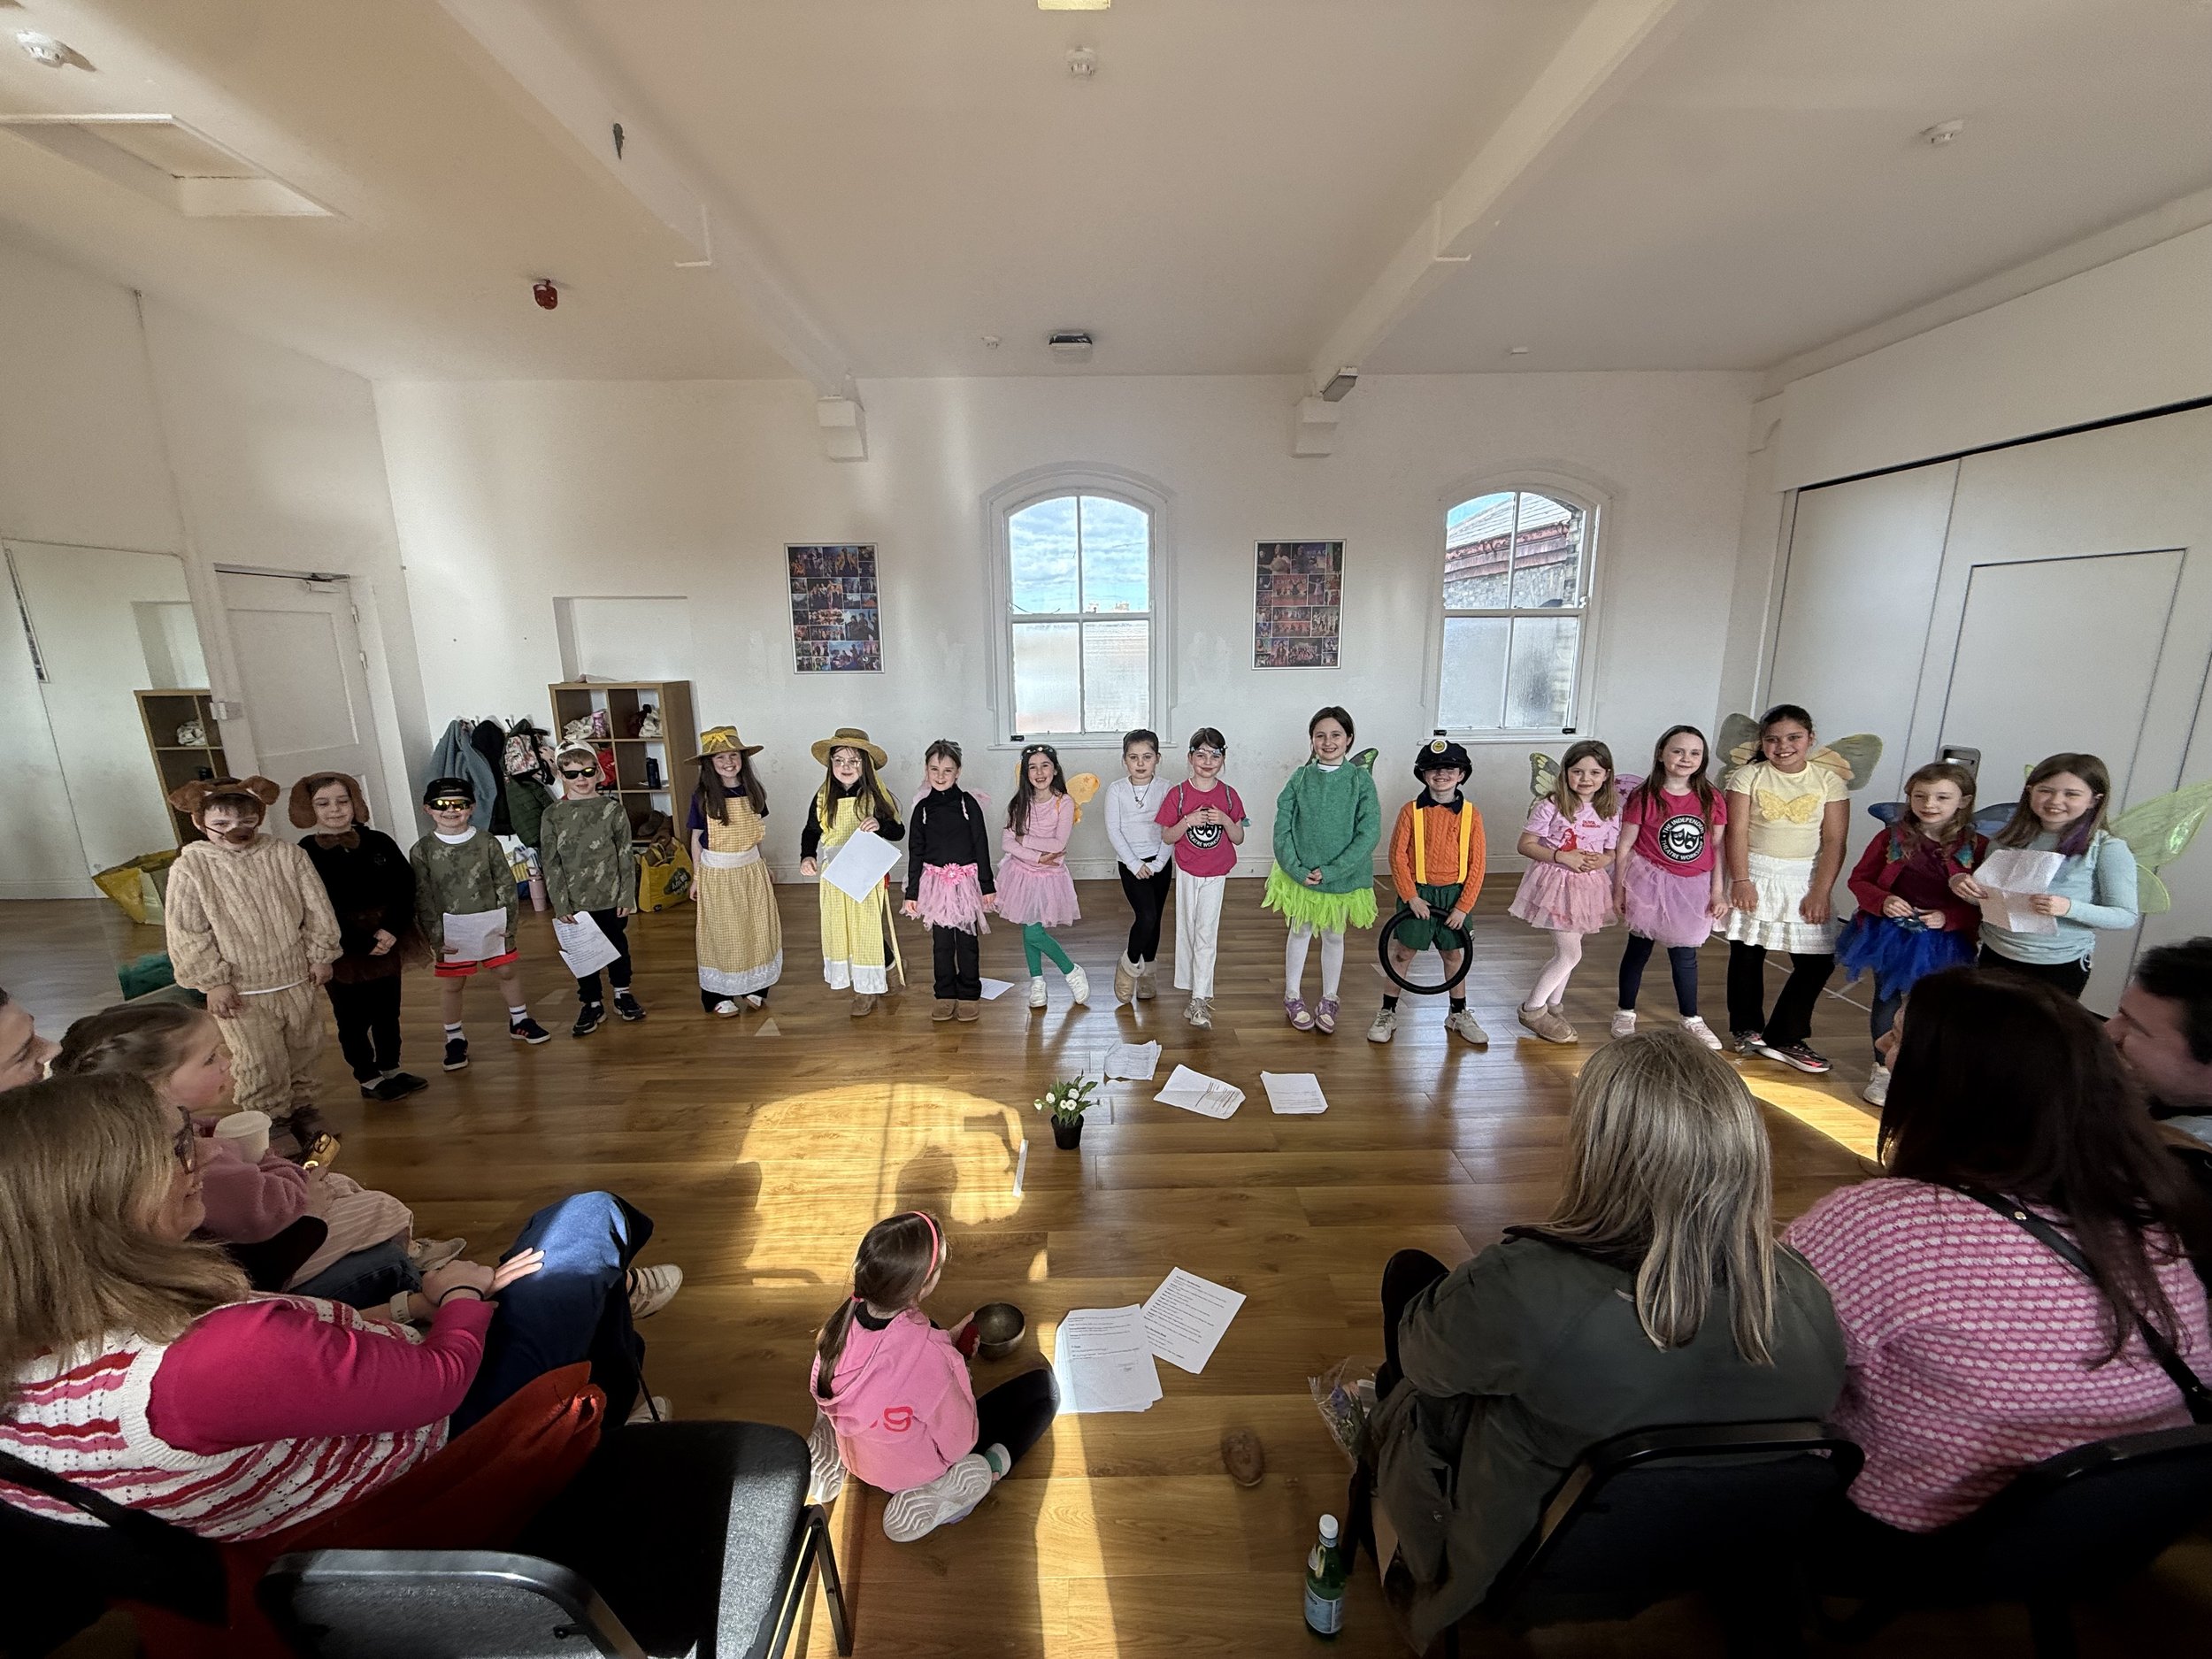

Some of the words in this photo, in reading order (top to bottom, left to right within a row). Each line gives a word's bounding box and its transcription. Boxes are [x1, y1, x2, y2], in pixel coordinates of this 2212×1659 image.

[1663, 823, 1673, 833] THE
[1671, 818, 1704, 834] INDEPENDENT
[1187, 830, 1202, 847] THEATRE
[1661, 840, 1679, 860] THEATRE
[1680, 841, 1704, 860] WORKSHOP
